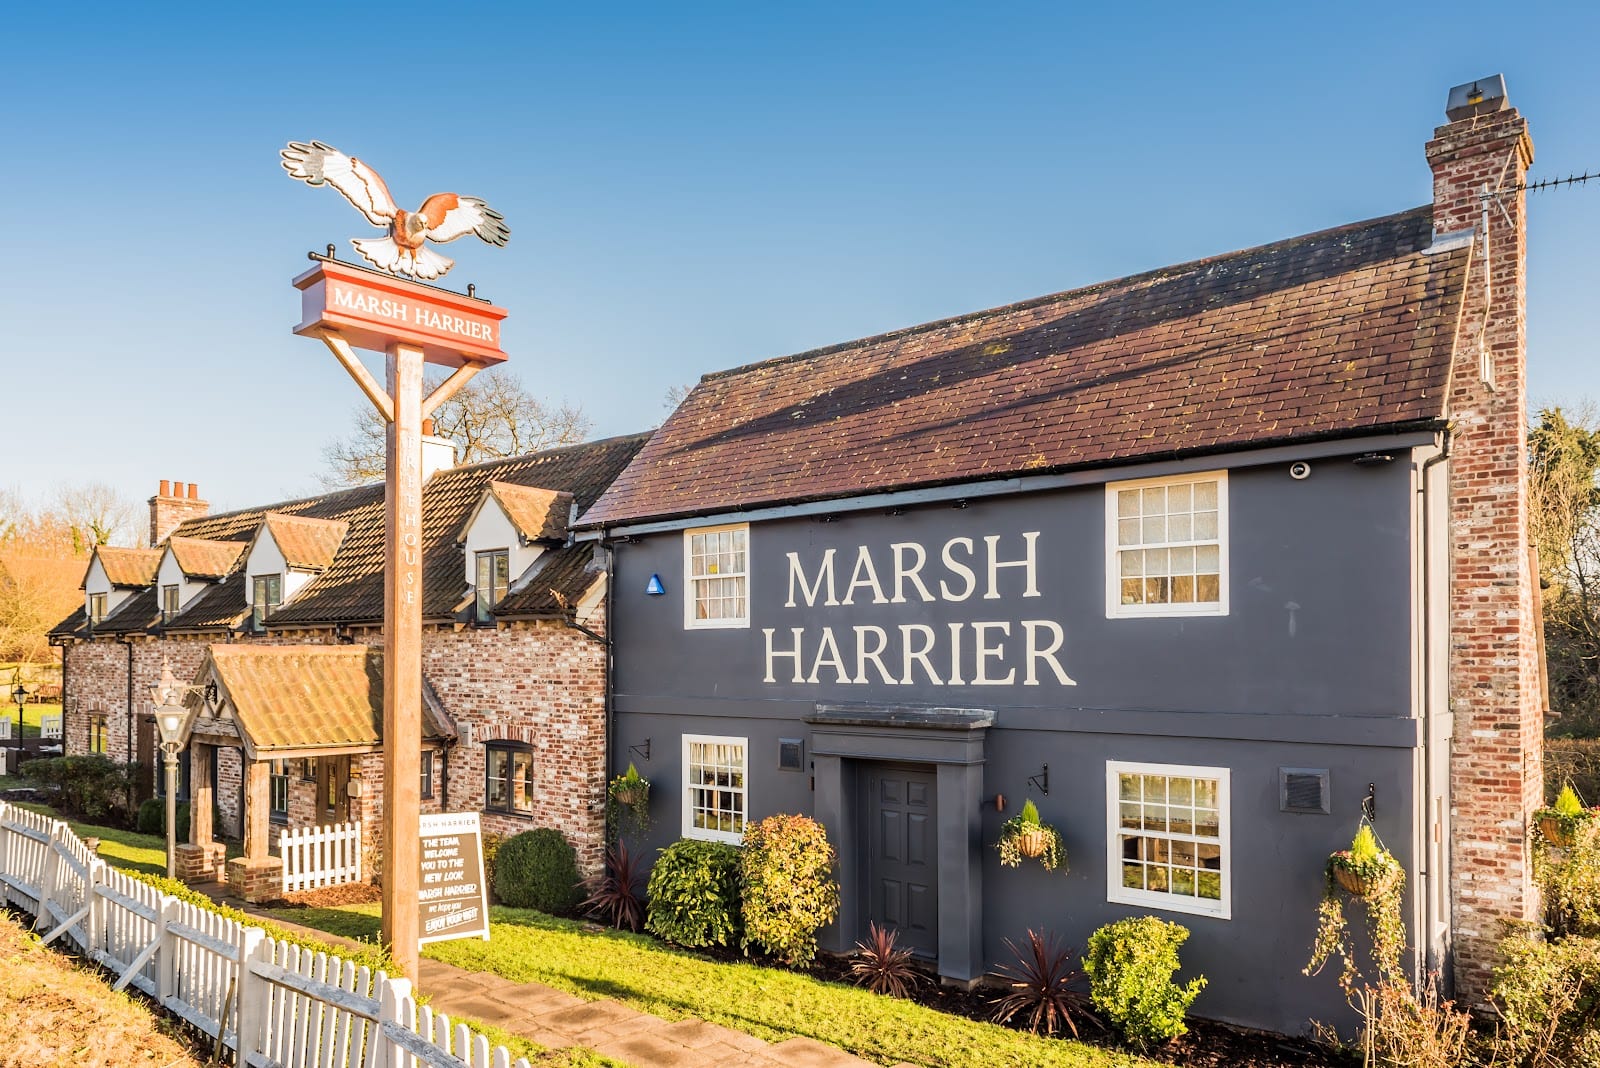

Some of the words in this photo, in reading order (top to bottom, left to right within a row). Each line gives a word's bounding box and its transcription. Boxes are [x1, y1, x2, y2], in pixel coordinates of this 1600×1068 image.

[334, 287, 408, 322] MARSH
[415, 308, 493, 342] HARRIER
[784, 531, 1041, 608] MARSH
[762, 620, 1077, 686] HARRIER
[420, 821, 438, 829] RSH
[441, 819, 476, 828] HARRIER
[422, 838, 439, 849] THE
[440, 836, 460, 847] TEAM
[424, 848, 459, 860] WELCOME
[421, 860, 436, 871] YOU
[437, 859, 448, 870] TO
[449, 858, 465, 868] THE
[424, 872, 442, 884] NEW
[444, 870, 465, 882] LOOK
[444, 883, 477, 897] HARRIER
[428, 904, 438, 913] we
[438, 902, 451, 913] hope
[451, 902, 462, 914] you
[425, 917, 446, 932] ENJOY
[446, 912, 463, 927] YOUR
[462, 907, 478, 921] VISIT
